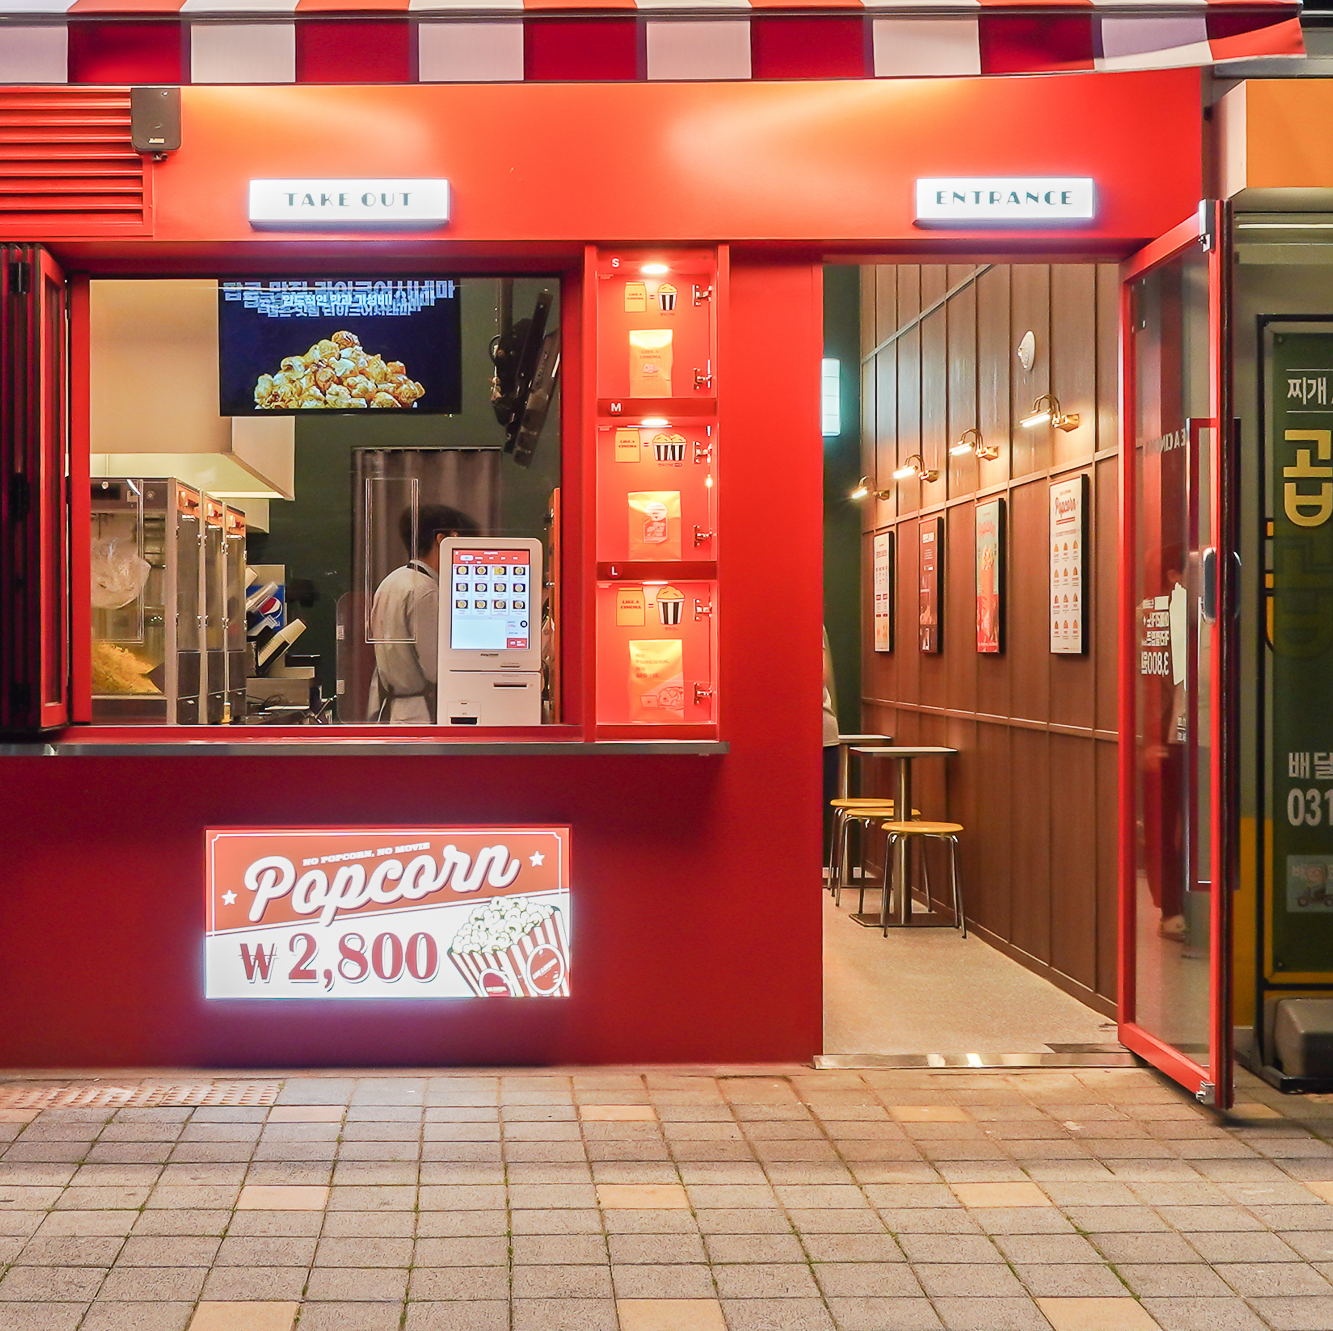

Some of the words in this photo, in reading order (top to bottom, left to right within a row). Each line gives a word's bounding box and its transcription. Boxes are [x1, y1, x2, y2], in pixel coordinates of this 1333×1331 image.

[284, 191, 353, 207] TAKE
[360, 191, 415, 207] OUT
[935, 189, 1074, 206] ENTRANCE
[612, 258, 620, 268] S
[610, 402, 622, 412] M
[611, 566, 618, 576] L
[302, 857, 319, 867] NO
[377, 846, 393, 856] NO
[395, 841, 431, 855] MOVIE
[243, 844, 521, 927] Popcorn
[287, 931, 440, 992] 2,800
